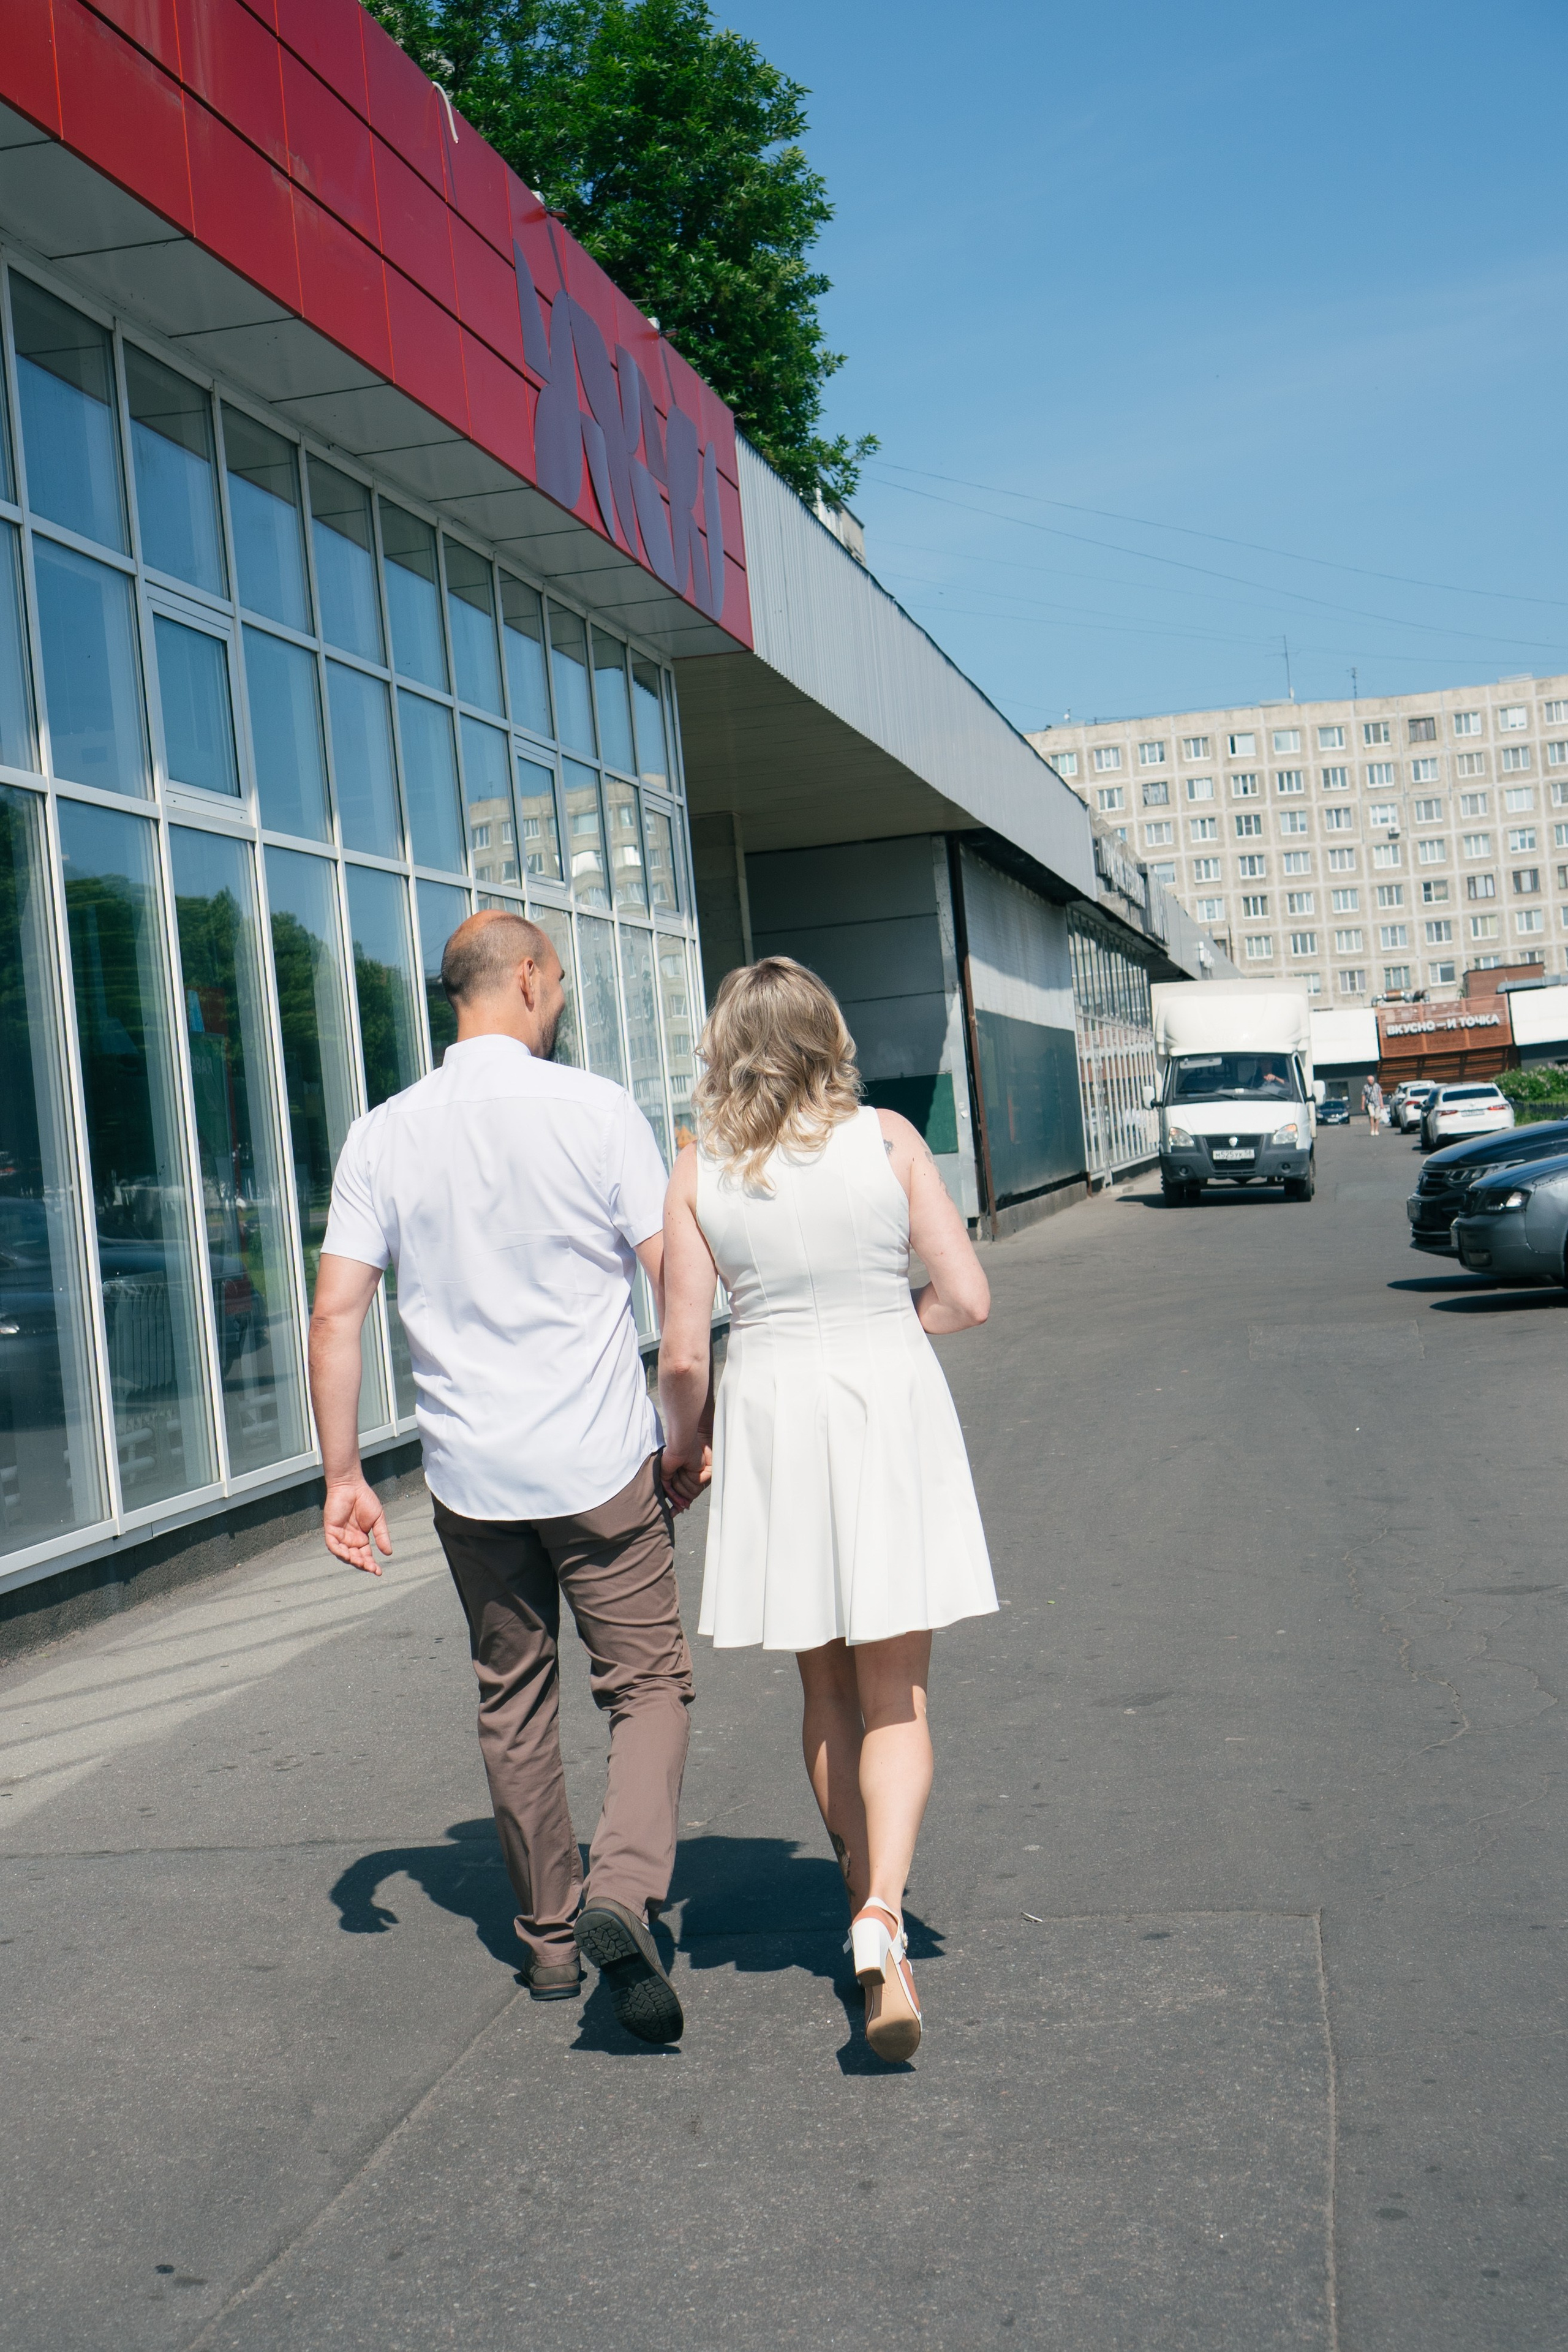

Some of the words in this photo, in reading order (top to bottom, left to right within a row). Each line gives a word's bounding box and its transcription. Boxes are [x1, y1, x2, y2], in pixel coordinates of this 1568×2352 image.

[1387, 1020, 1435, 1035] ВКУСНО
[1447, 1018, 1457, 1029] И
[1458, 1014, 1500, 1028] ТОЧКА
